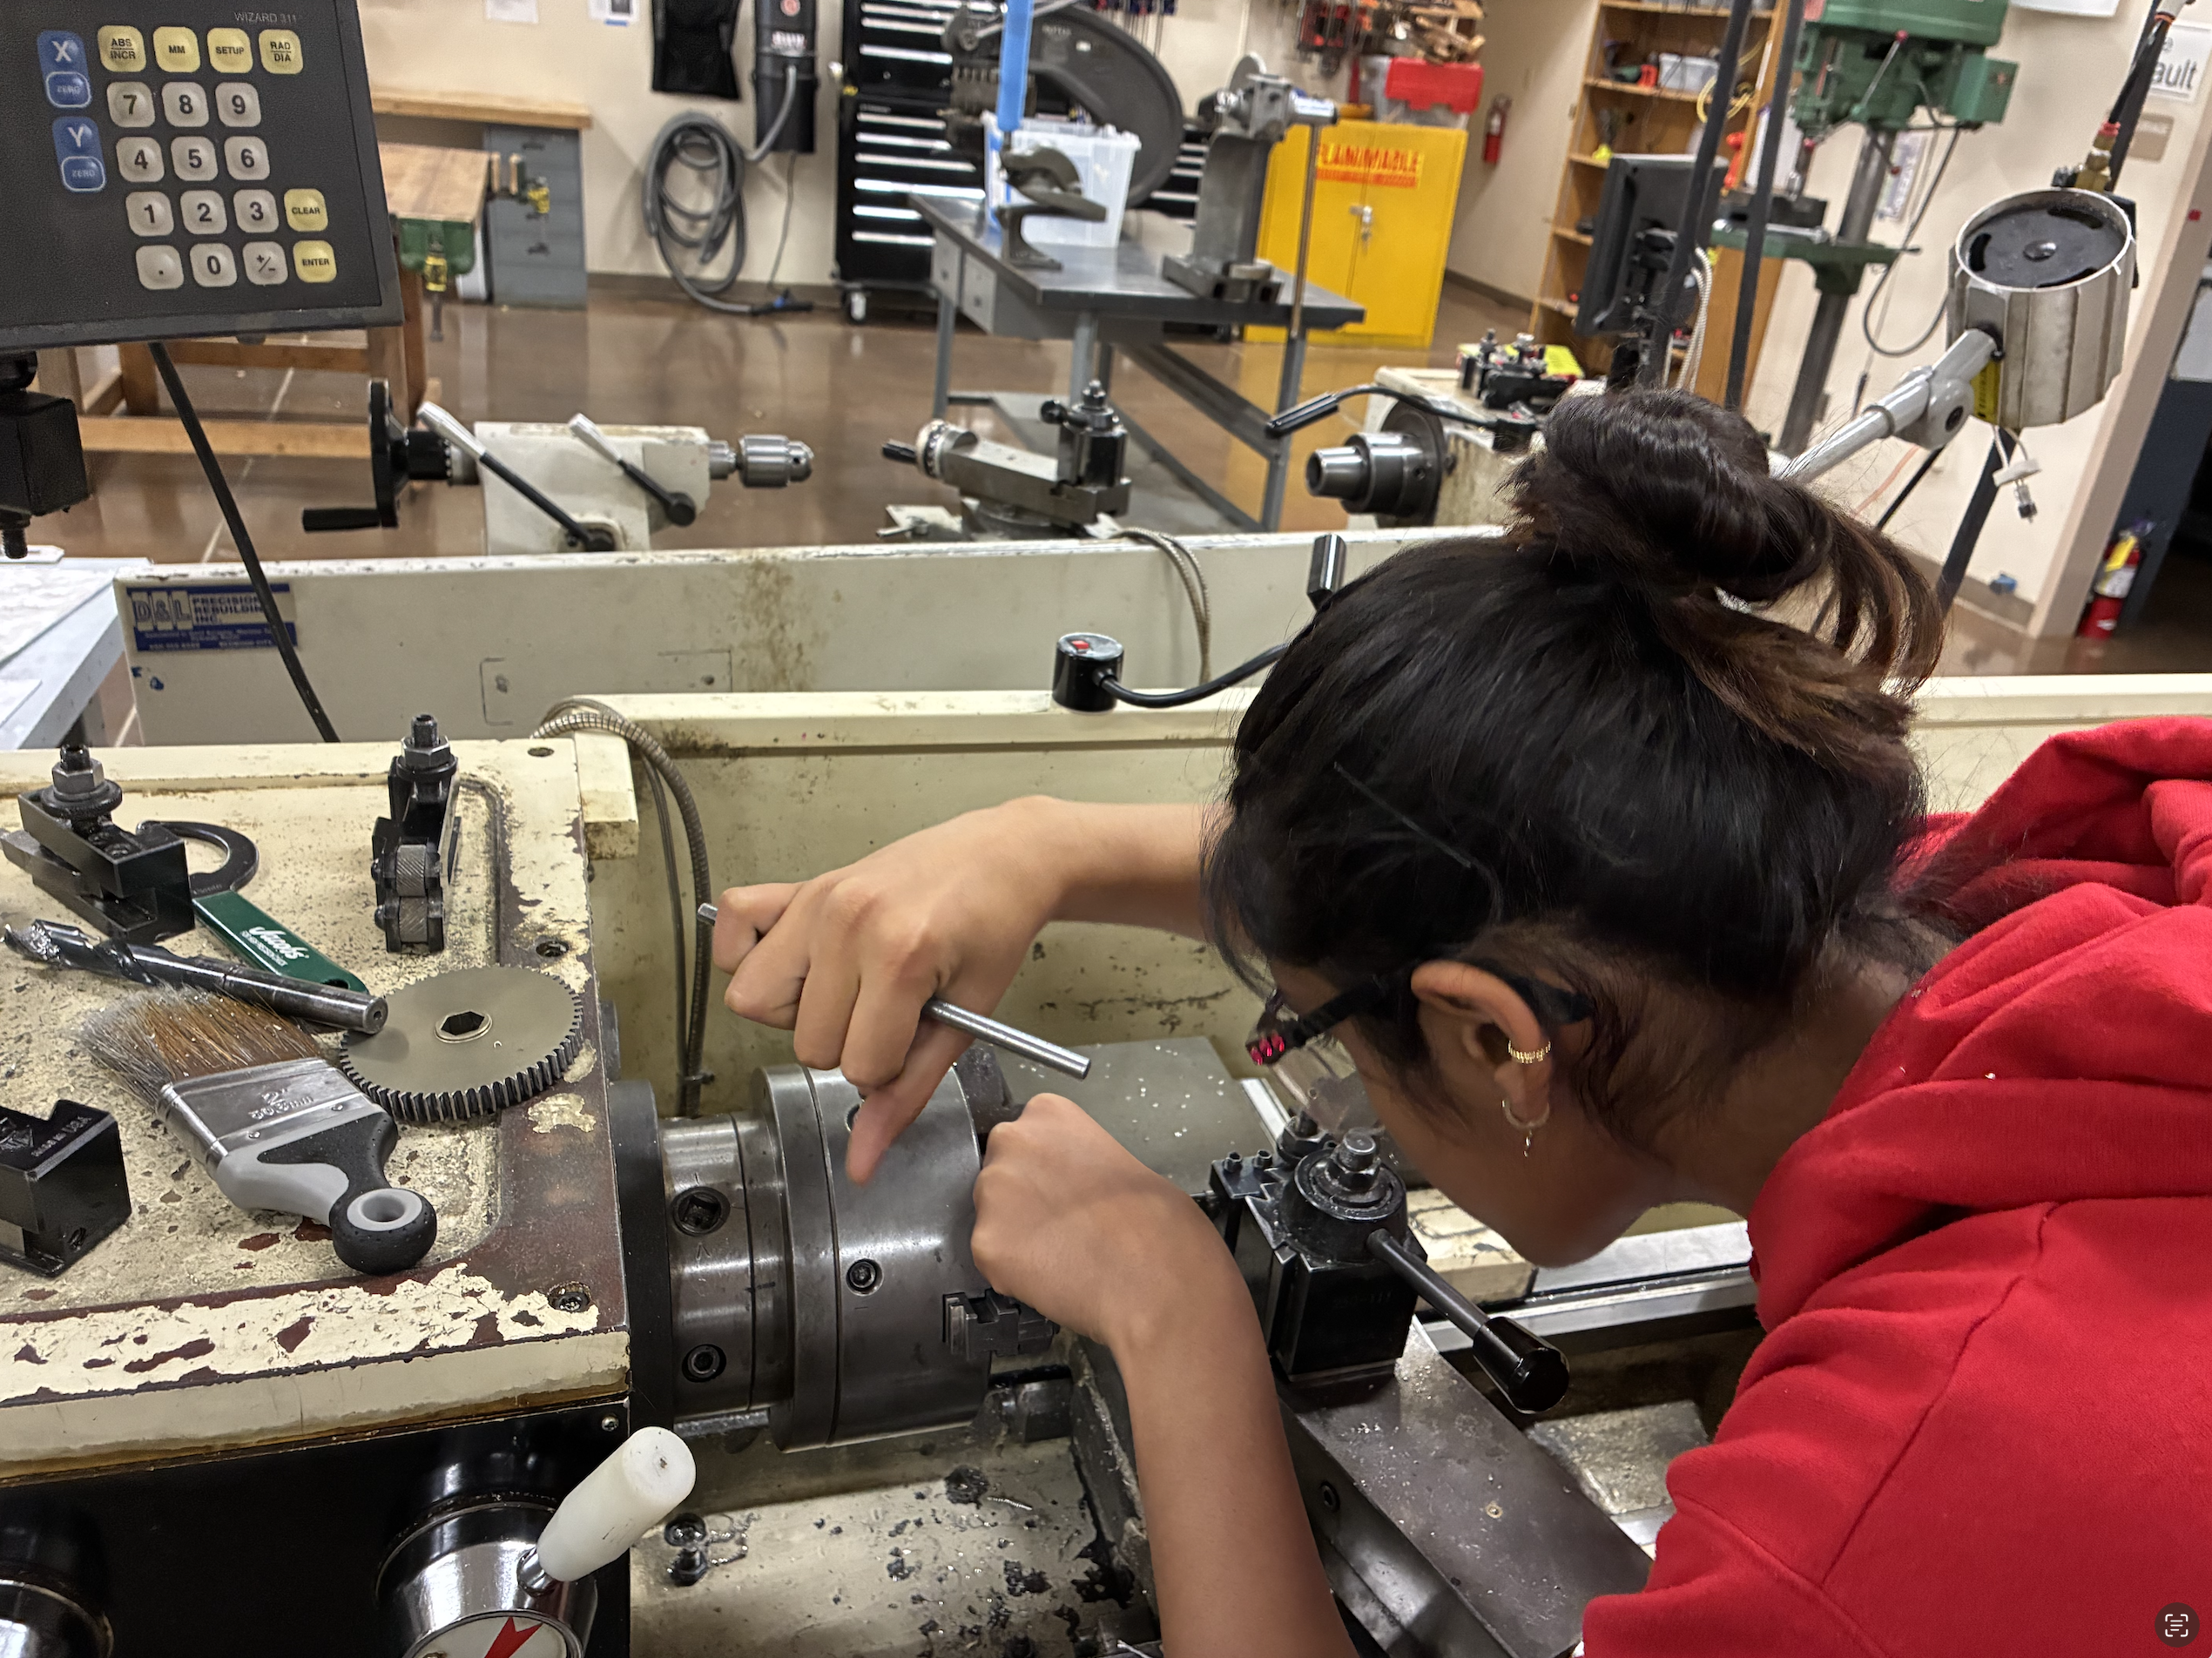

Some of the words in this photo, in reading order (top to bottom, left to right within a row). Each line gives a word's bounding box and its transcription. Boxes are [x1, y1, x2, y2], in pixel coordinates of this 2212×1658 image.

[233, 11, 278, 24] WIZARD
[53, 40, 72, 63] X
[111, 38, 132, 47] ABS
[168, 45, 185, 54] MM
[215, 45, 244, 55] SETUP
[270, 41, 291, 50] RAD
[111, 51, 136, 60] INCR
[273, 53, 292, 62] DIA
[2152, 59, 2197, 88] ault
[124, 95, 137, 115] 7
[179, 95, 193, 114] 8
[232, 95, 246, 114] 9
[68, 126, 84, 148] Y
[134, 150, 148, 169] 4
[188, 149, 202, 169] 5
[240, 149, 254, 168] 6
[71, 169, 96, 178] ZERO
[145, 205, 155, 224] 1
[198, 204, 212, 222] 2
[250, 202, 264, 220] 3
[207, 255, 221, 274] 0
[194, 604, 262, 614] REBUILDIN
